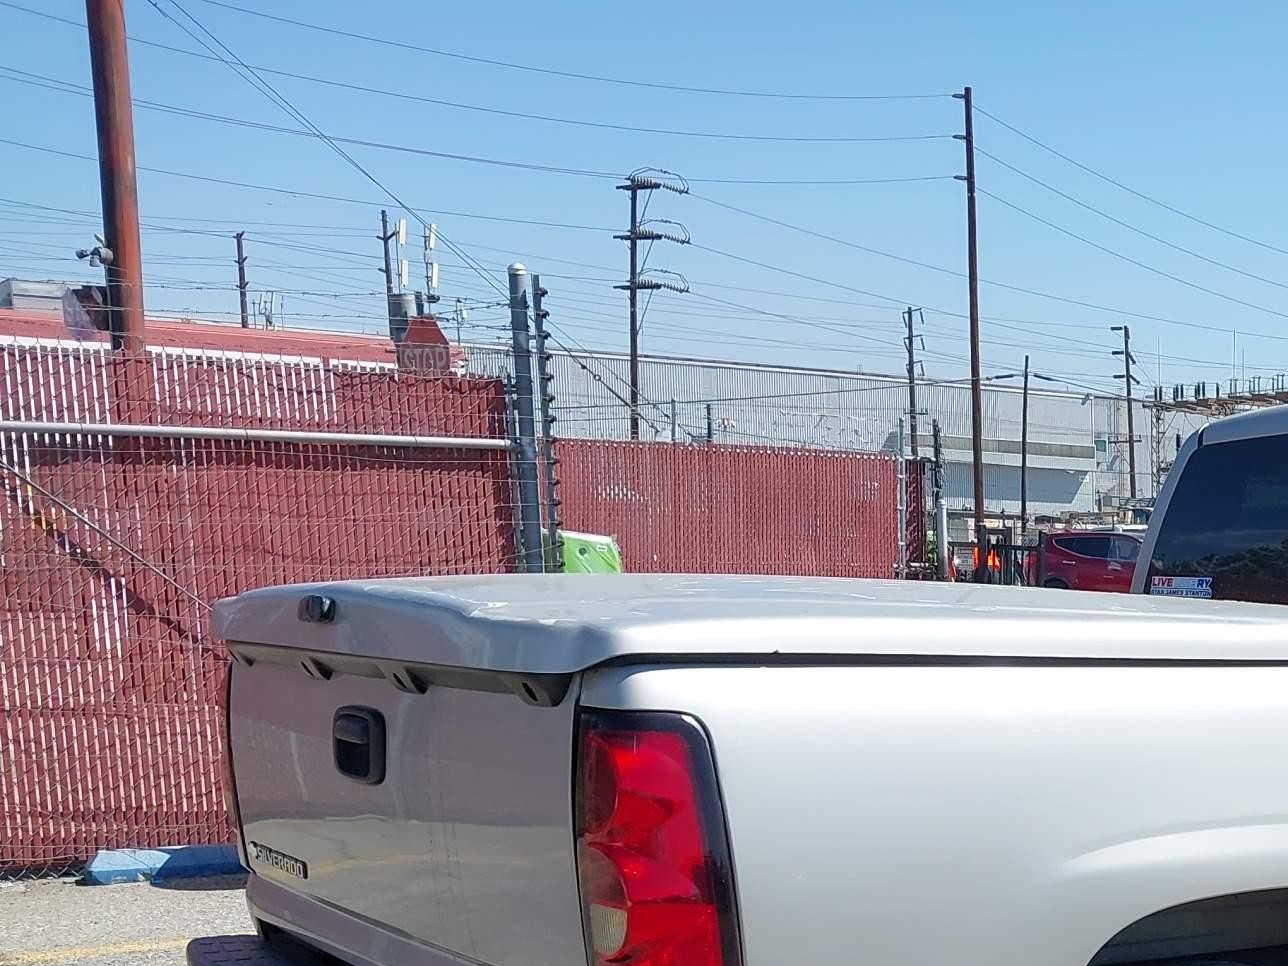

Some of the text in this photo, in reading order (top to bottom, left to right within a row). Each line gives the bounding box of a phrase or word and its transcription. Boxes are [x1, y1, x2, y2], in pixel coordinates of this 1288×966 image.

[403, 347, 447, 377] STOP
[1152, 577, 1174, 588] LIVE
[1196, 578, 1212, 589] RY
[256, 847, 304, 878] SILVERADO
